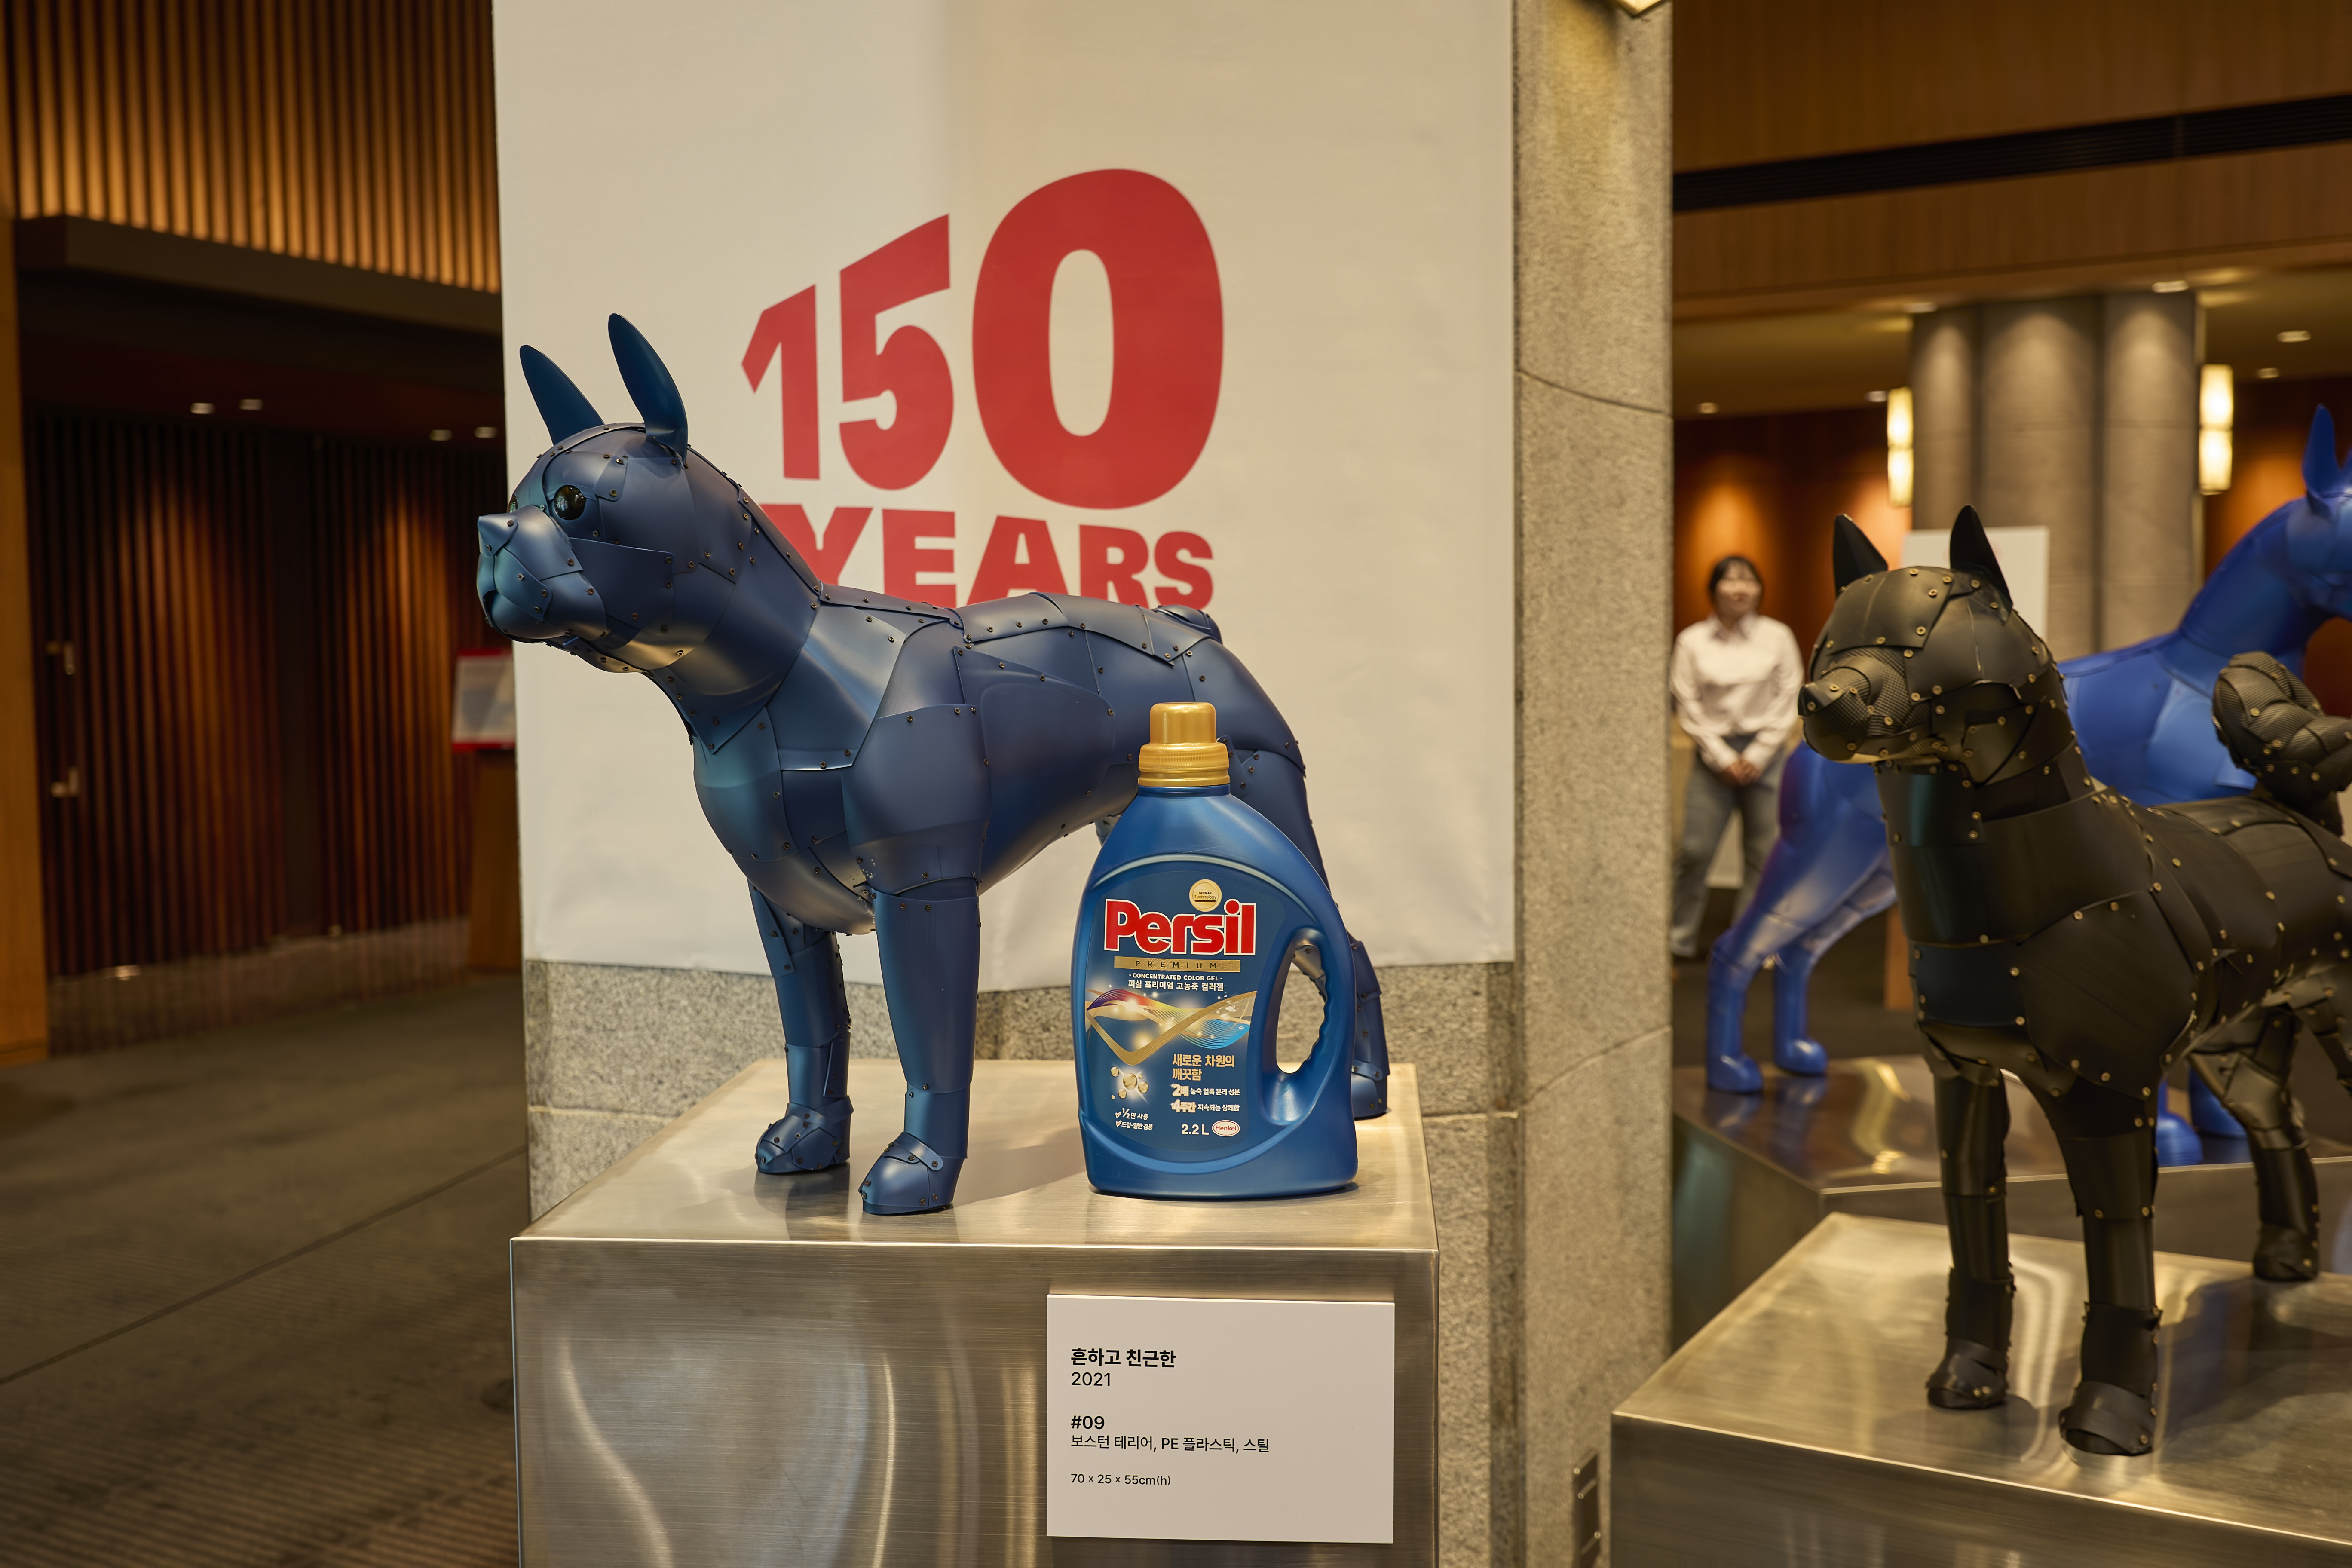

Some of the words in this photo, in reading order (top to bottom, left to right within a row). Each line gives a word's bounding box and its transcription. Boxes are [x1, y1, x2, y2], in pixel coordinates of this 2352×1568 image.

[742, 169, 1223, 509] 150
[759, 504, 1213, 610] YEARS
[1104, 899, 1256, 955] Persil
[1136, 960, 1216, 968] PREMIUM
[1128, 980, 1142, 989] 퍼실
[1145, 980, 1174, 989] 프리미엄
[1176, 982, 1199, 991] 고농축
[1201, 982, 1224, 991] 컬러젤
[1172, 1054, 1202, 1067] 새로운
[1205, 1054, 1235, 1067] 차원의
[1172, 1068, 1202, 1081] 깨끗함
[1172, 1084, 1189, 1097] 2배
[1171, 1099, 1197, 1113] 4주간
[1181, 1124, 1199, 1135] 2.2
[1201, 1124, 1210, 1135] L
[1071, 1348, 1121, 1366] 흔하고
[1126, 1349, 1176, 1368] 친근한
[1071, 1372, 1110, 1386] 2021
[1071, 1415, 1105, 1430] #09
[1071, 1435, 1109, 1449] 보스턴
[1114, 1436, 1157, 1452] 테리어,
[1161, 1438, 1179, 1449] PE
[1183, 1437, 1239, 1454] 플라스틱,
[1243, 1439, 1269, 1452] 스틸
[1071, 1473, 1085, 1483] 70
[1097, 1474, 1112, 1484] 25
[1124, 1475, 1171, 1485] 55cm(h)
